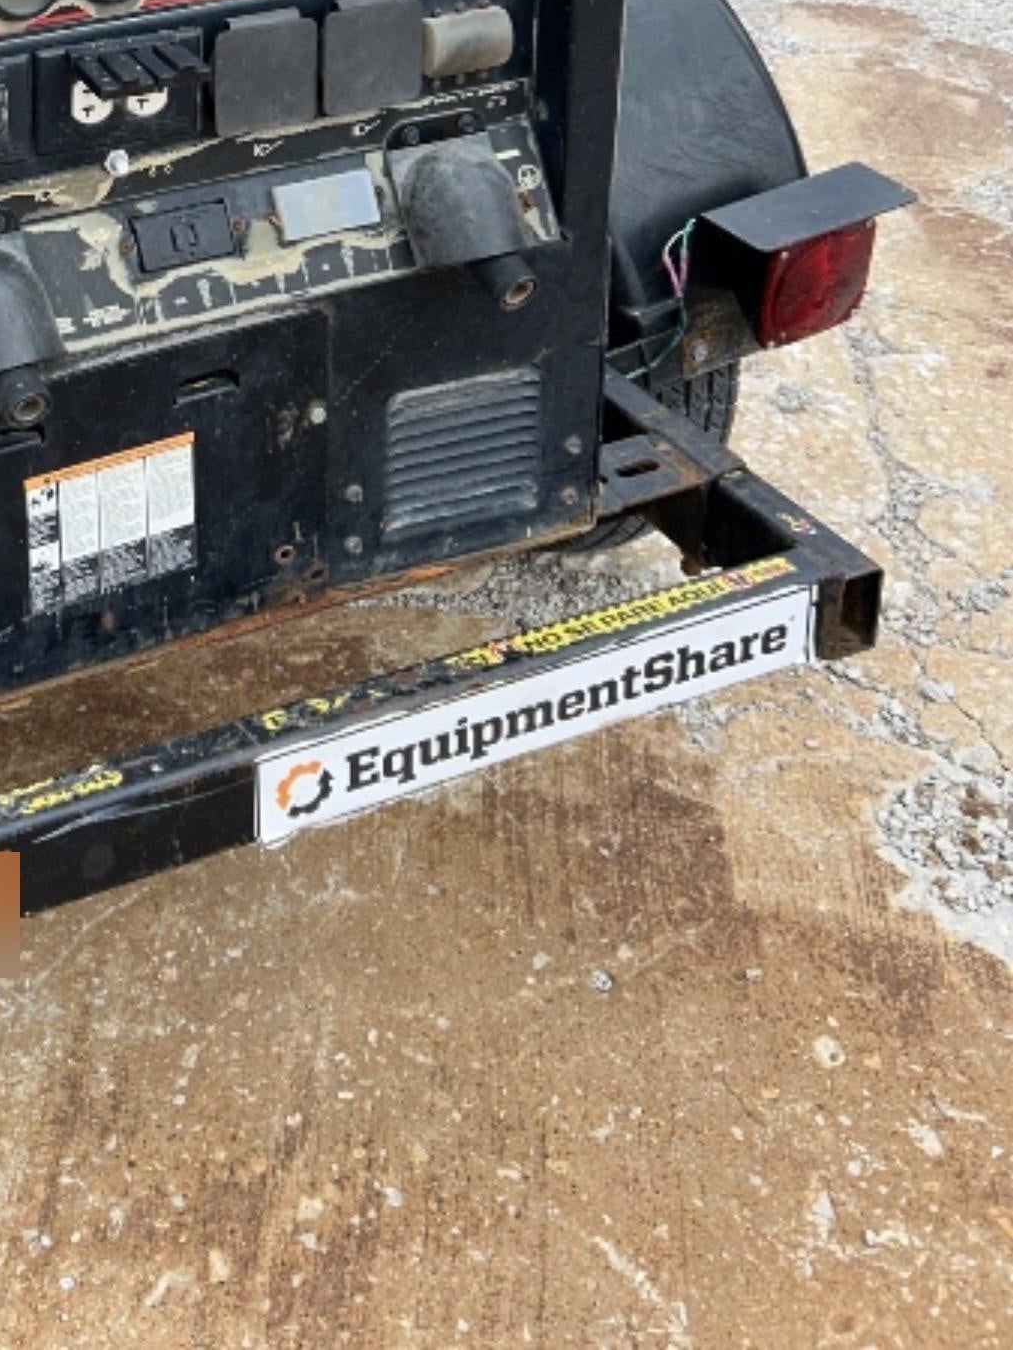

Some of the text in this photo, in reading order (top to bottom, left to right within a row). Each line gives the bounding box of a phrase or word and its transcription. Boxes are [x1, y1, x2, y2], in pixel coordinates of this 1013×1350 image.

[525, 631, 561, 650] NO
[563, 623, 593, 640] SE
[602, 601, 660, 630] PARE
[346, 622, 788, 794] EquipmentShare
